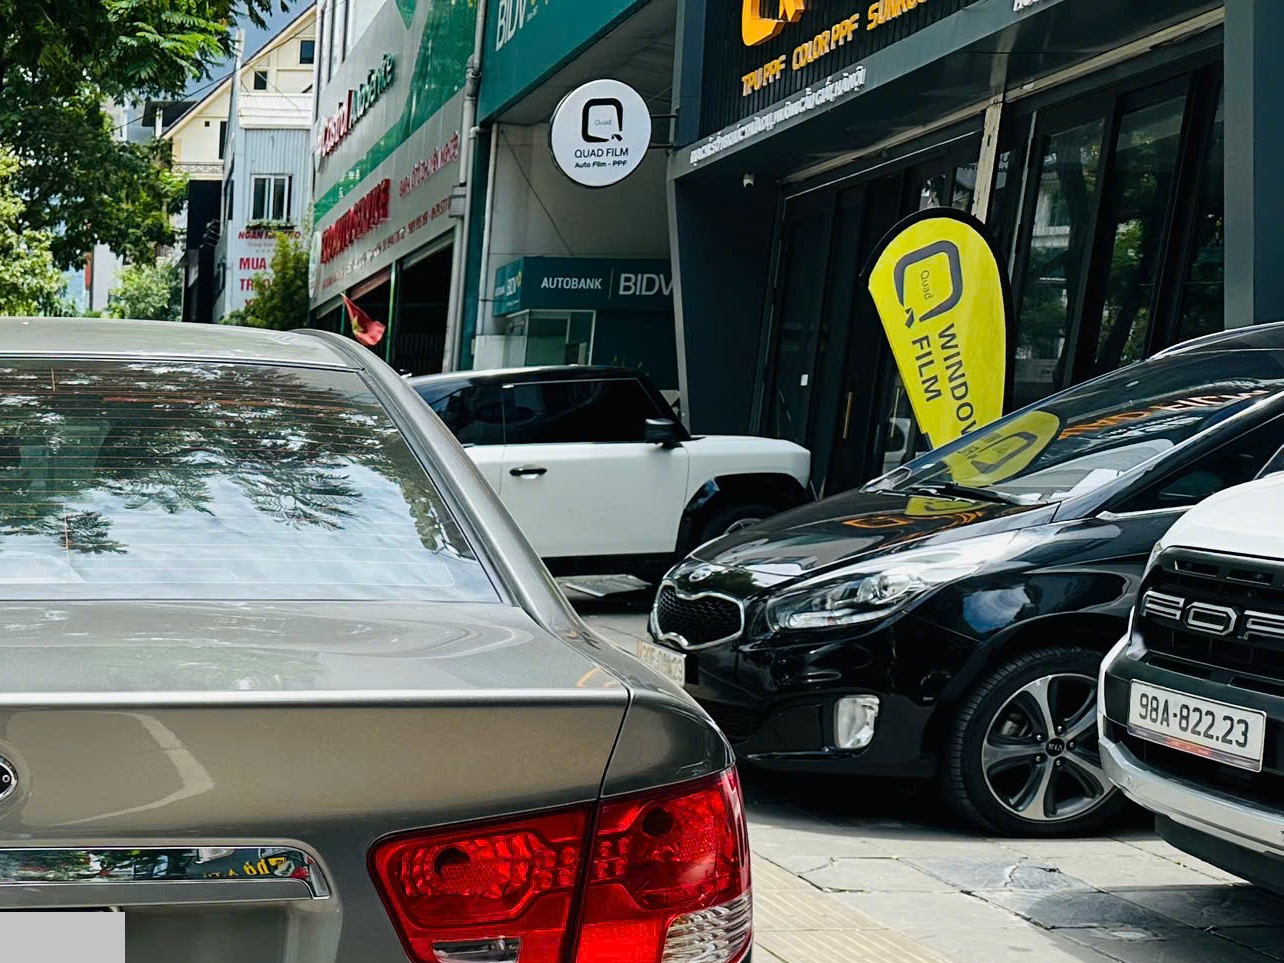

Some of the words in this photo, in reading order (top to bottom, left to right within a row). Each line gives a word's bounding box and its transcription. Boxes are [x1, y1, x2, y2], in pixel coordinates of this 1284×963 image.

[741, 67, 764, 97] TPU
[763, 54, 787, 86] PPF
[792, 30, 830, 71] COLOR
[830, 13, 859, 49] PPF
[574, 148, 604, 158] QUAD
[605, 147, 629, 157] FILM
[239, 257, 267, 270] MUA
[541, 277, 603, 290] AUTOBANK
[619, 273, 674, 296] BIDV
[920, 269, 935, 300] Quad
[912, 335, 942, 402] FILM
[1139, 693, 1249, 748] 98A-822.23
